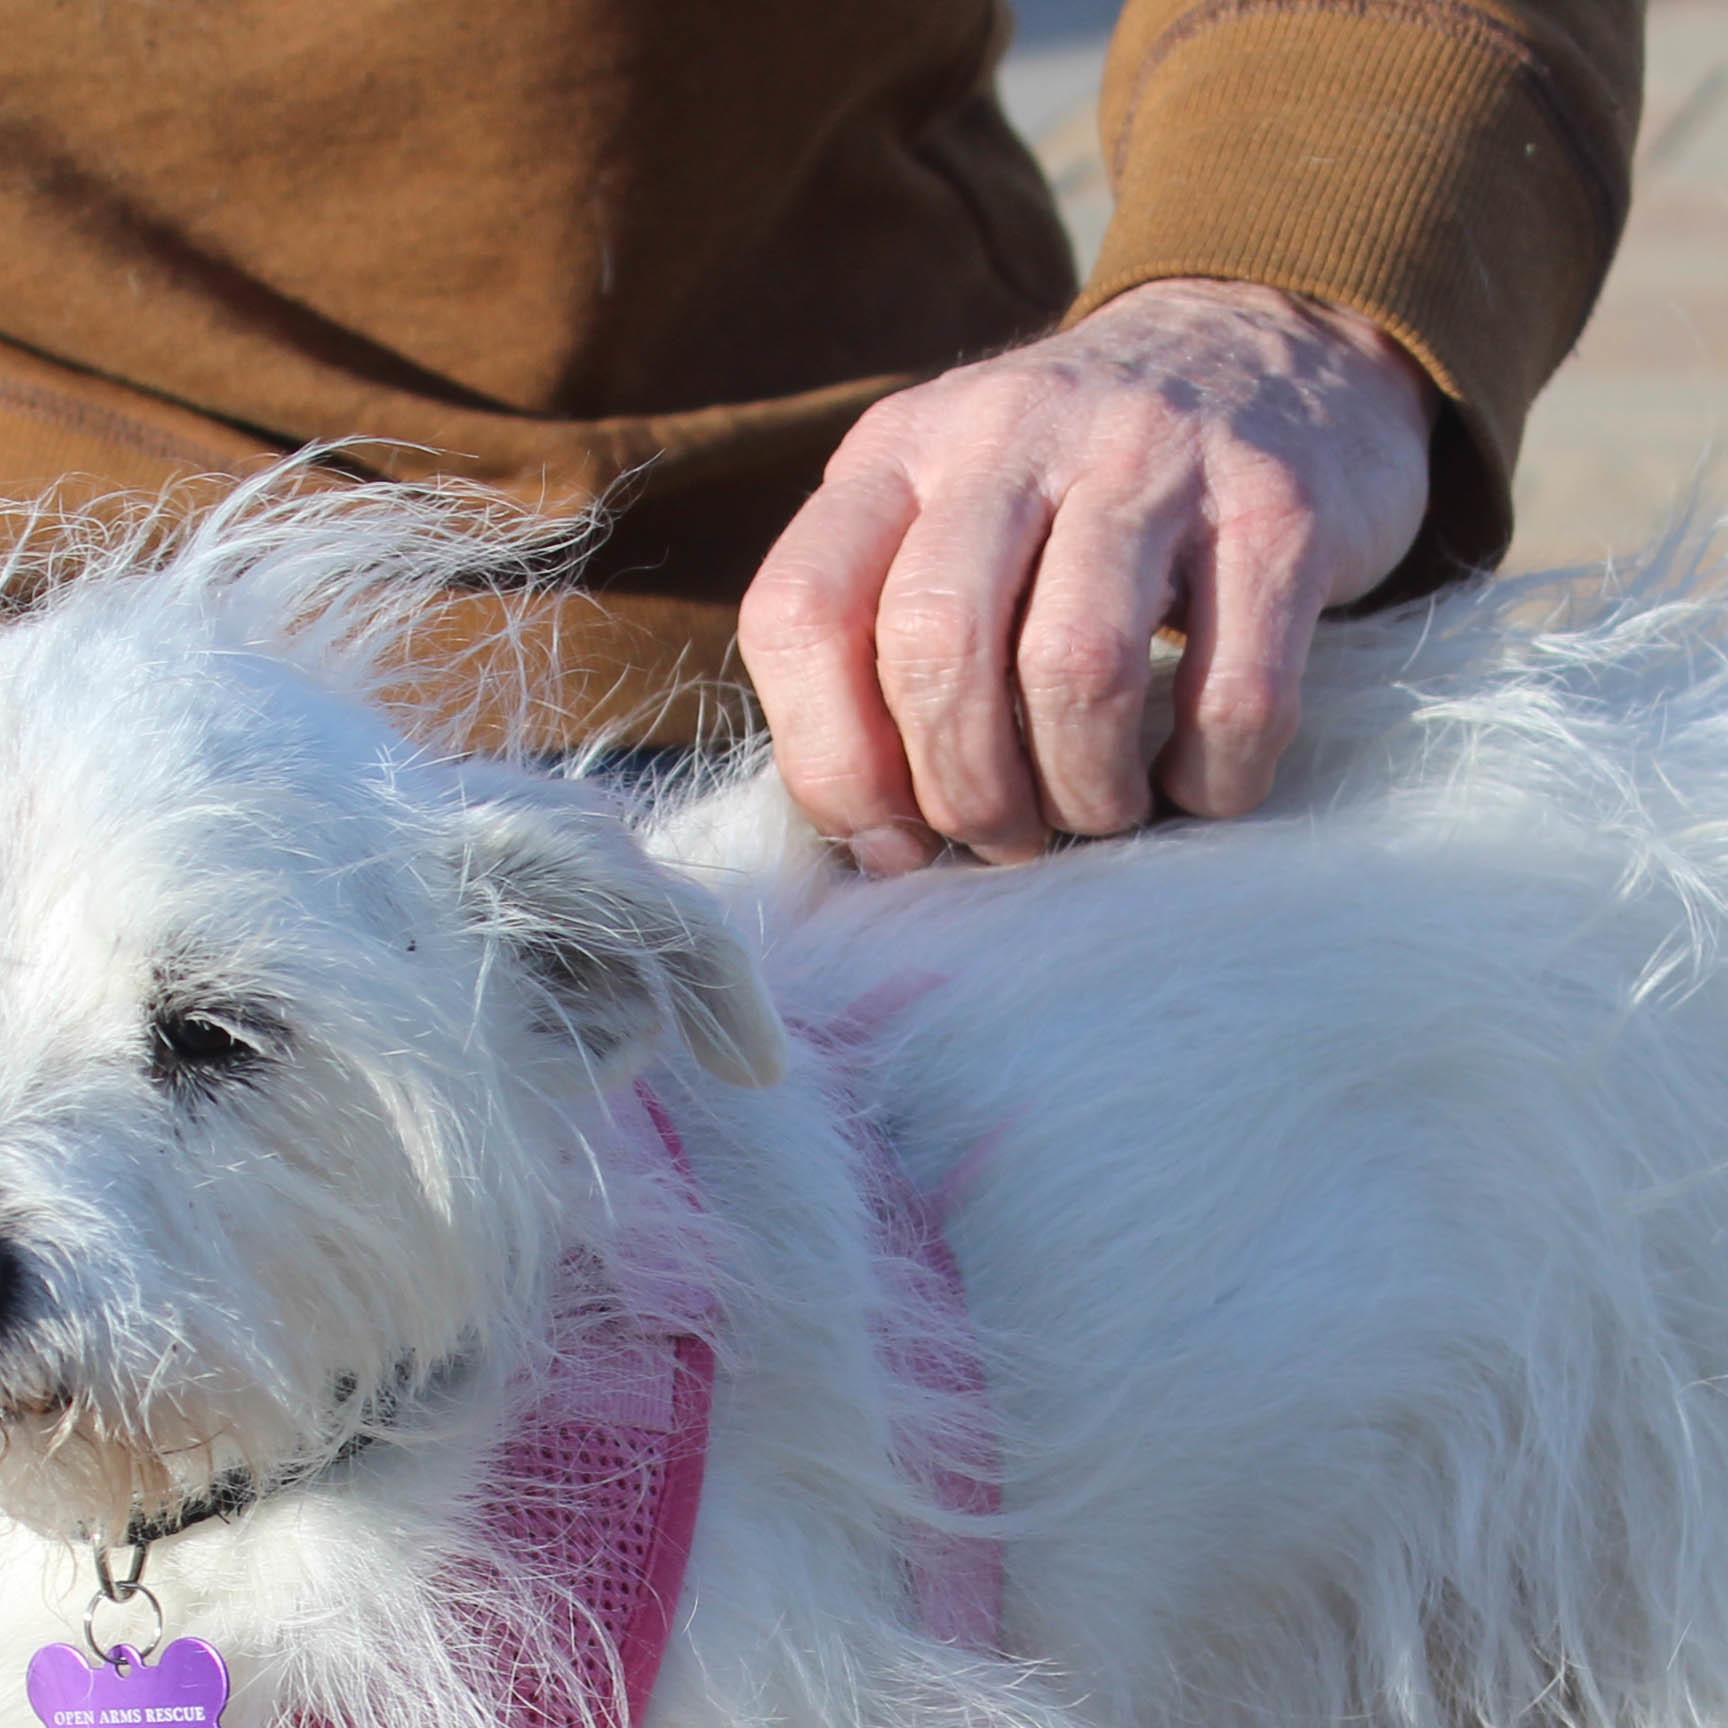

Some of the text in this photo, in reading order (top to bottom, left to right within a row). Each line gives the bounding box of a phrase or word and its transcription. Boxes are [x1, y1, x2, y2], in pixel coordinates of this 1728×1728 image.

[54, 1707, 206, 1725] OPEN ARMS RESCUE
